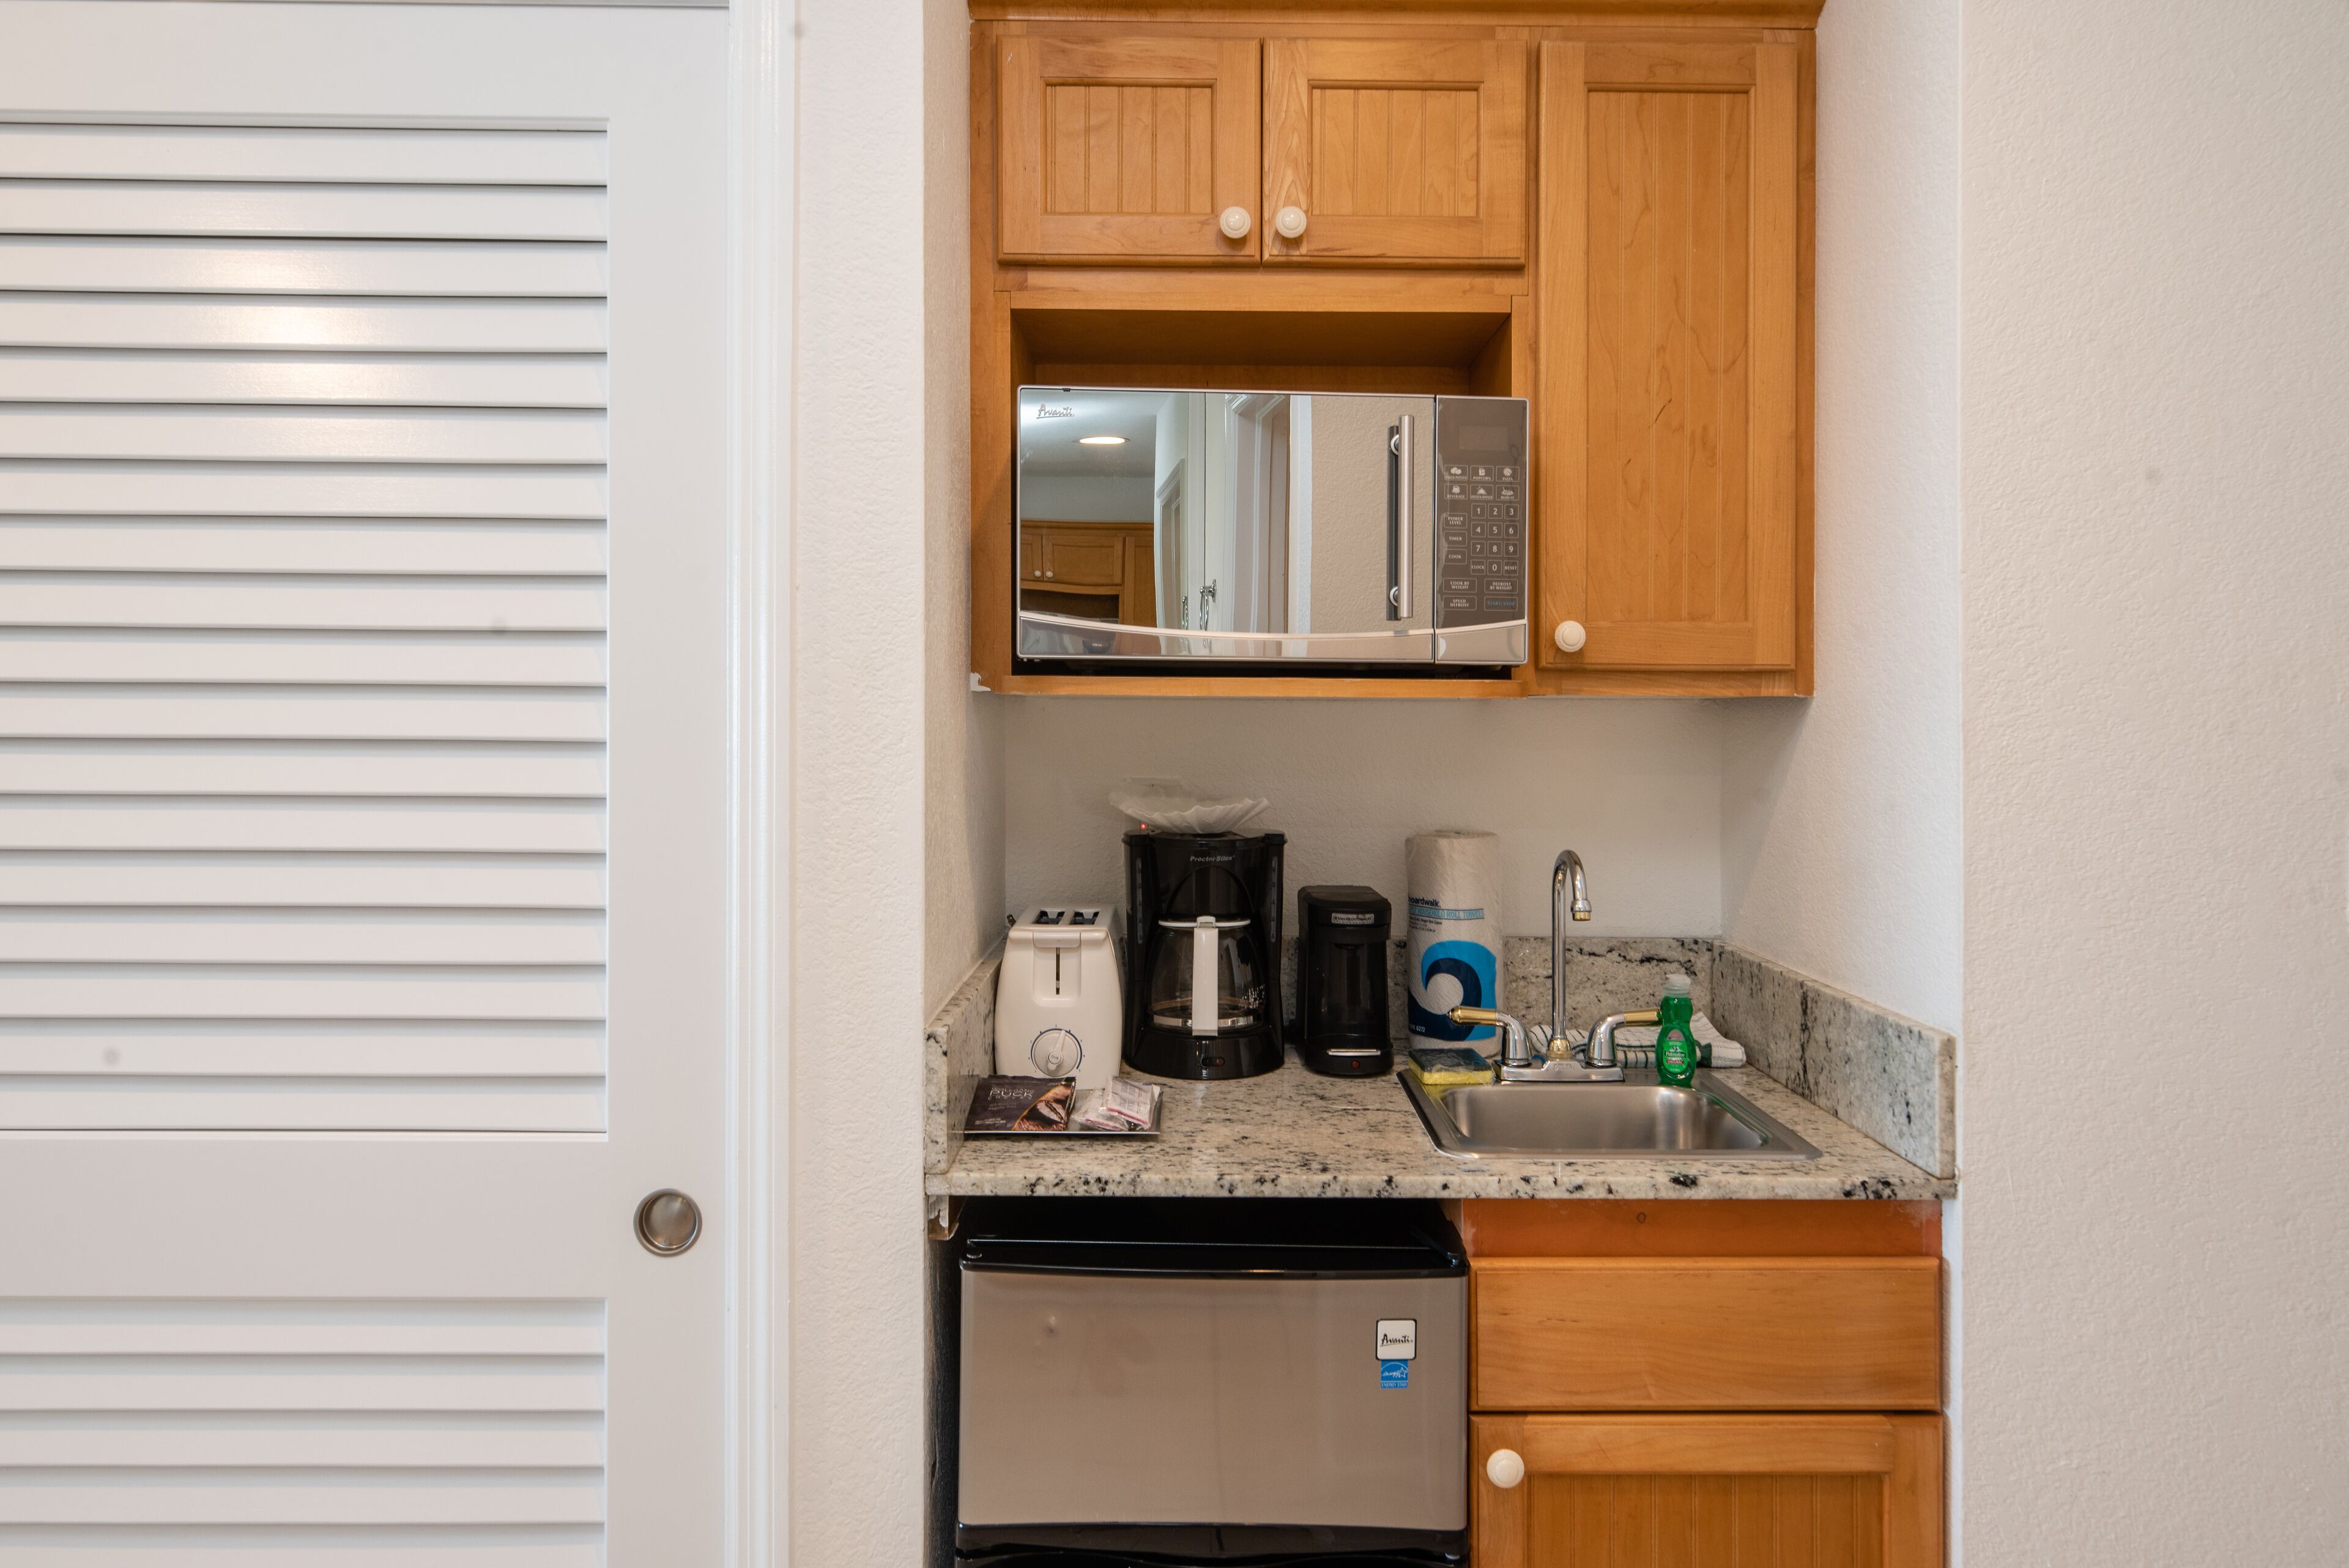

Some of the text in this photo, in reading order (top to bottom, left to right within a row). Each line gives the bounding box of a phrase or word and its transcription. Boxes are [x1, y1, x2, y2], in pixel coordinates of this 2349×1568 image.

[1037, 402, 1073, 417] Avanti
[1446, 910, 1461, 920] ROLL
[989, 1089, 1033, 1098] PUCK
[1381, 1333, 1409, 1345] Avanti
